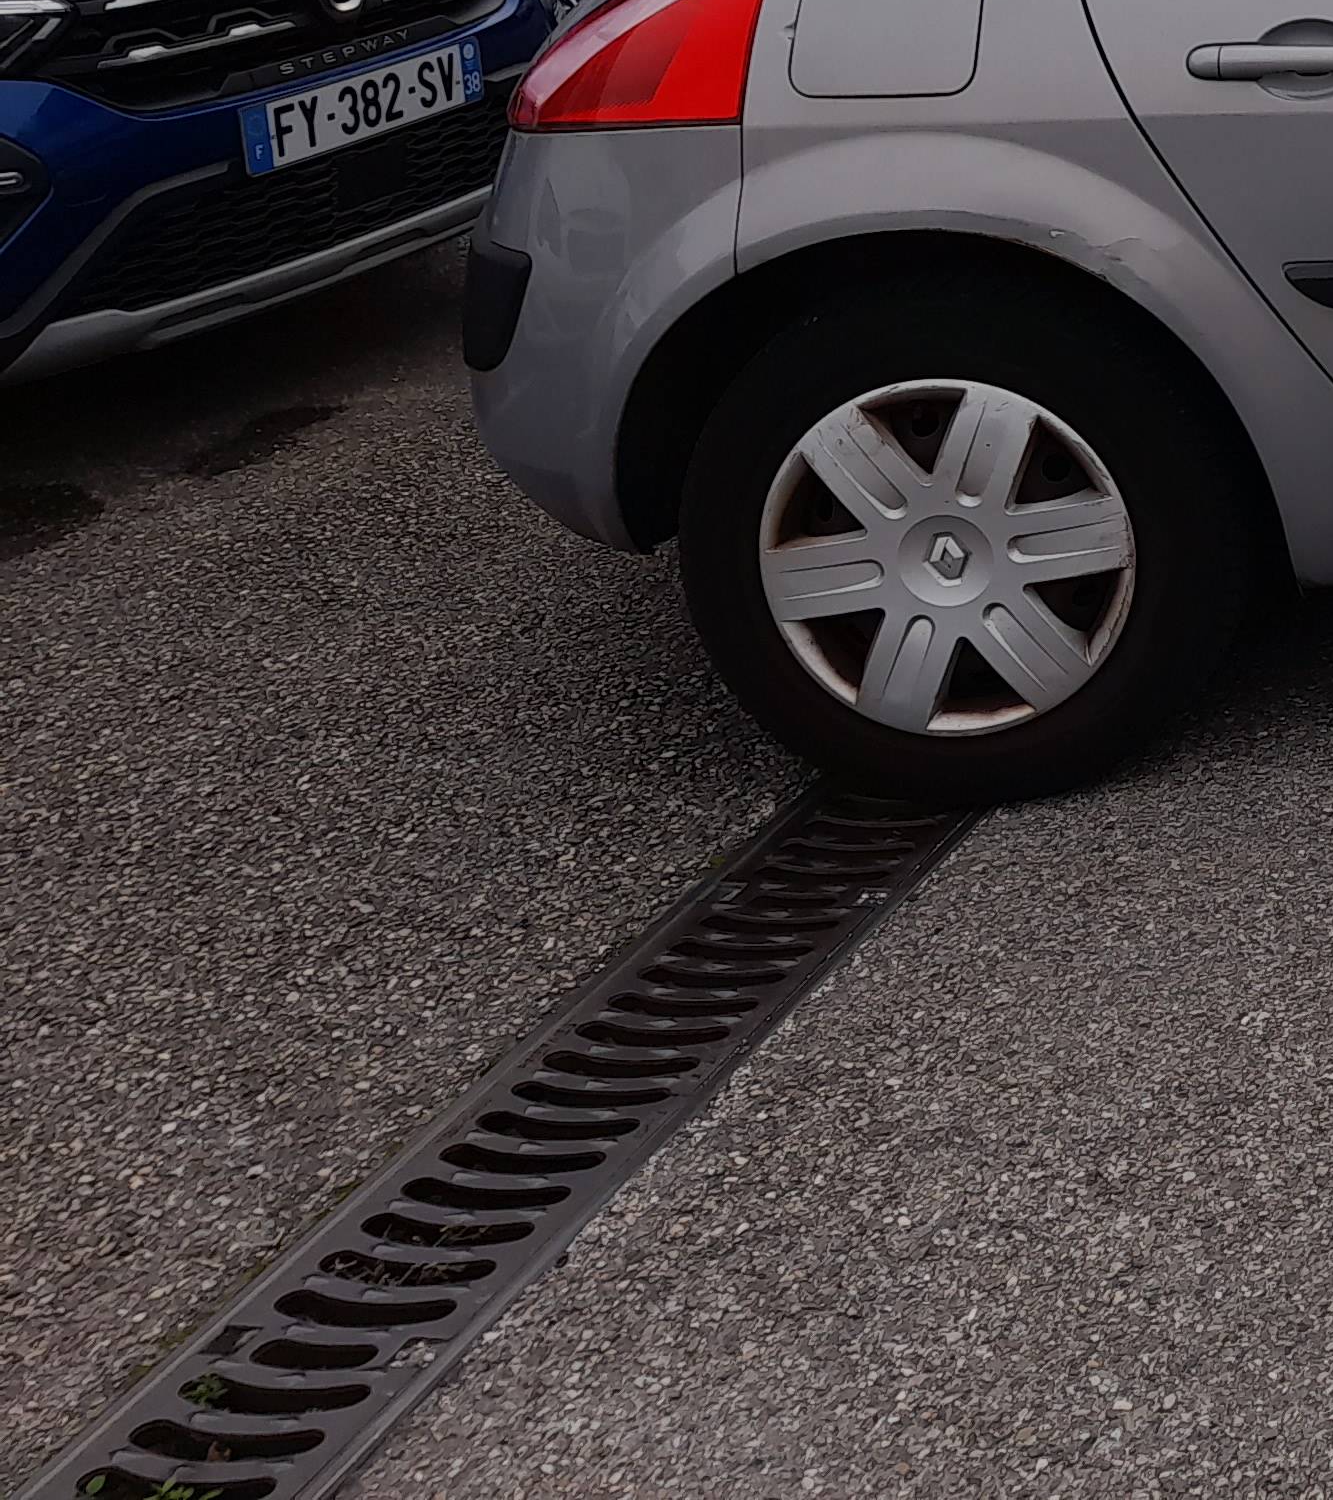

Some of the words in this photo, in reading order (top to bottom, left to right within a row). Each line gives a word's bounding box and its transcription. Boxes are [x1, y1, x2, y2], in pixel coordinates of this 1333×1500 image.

[279, 29, 409, 75] STEPWAY
[273, 53, 454, 157] FY-382-SV
[464, 71, 481, 95] 38
